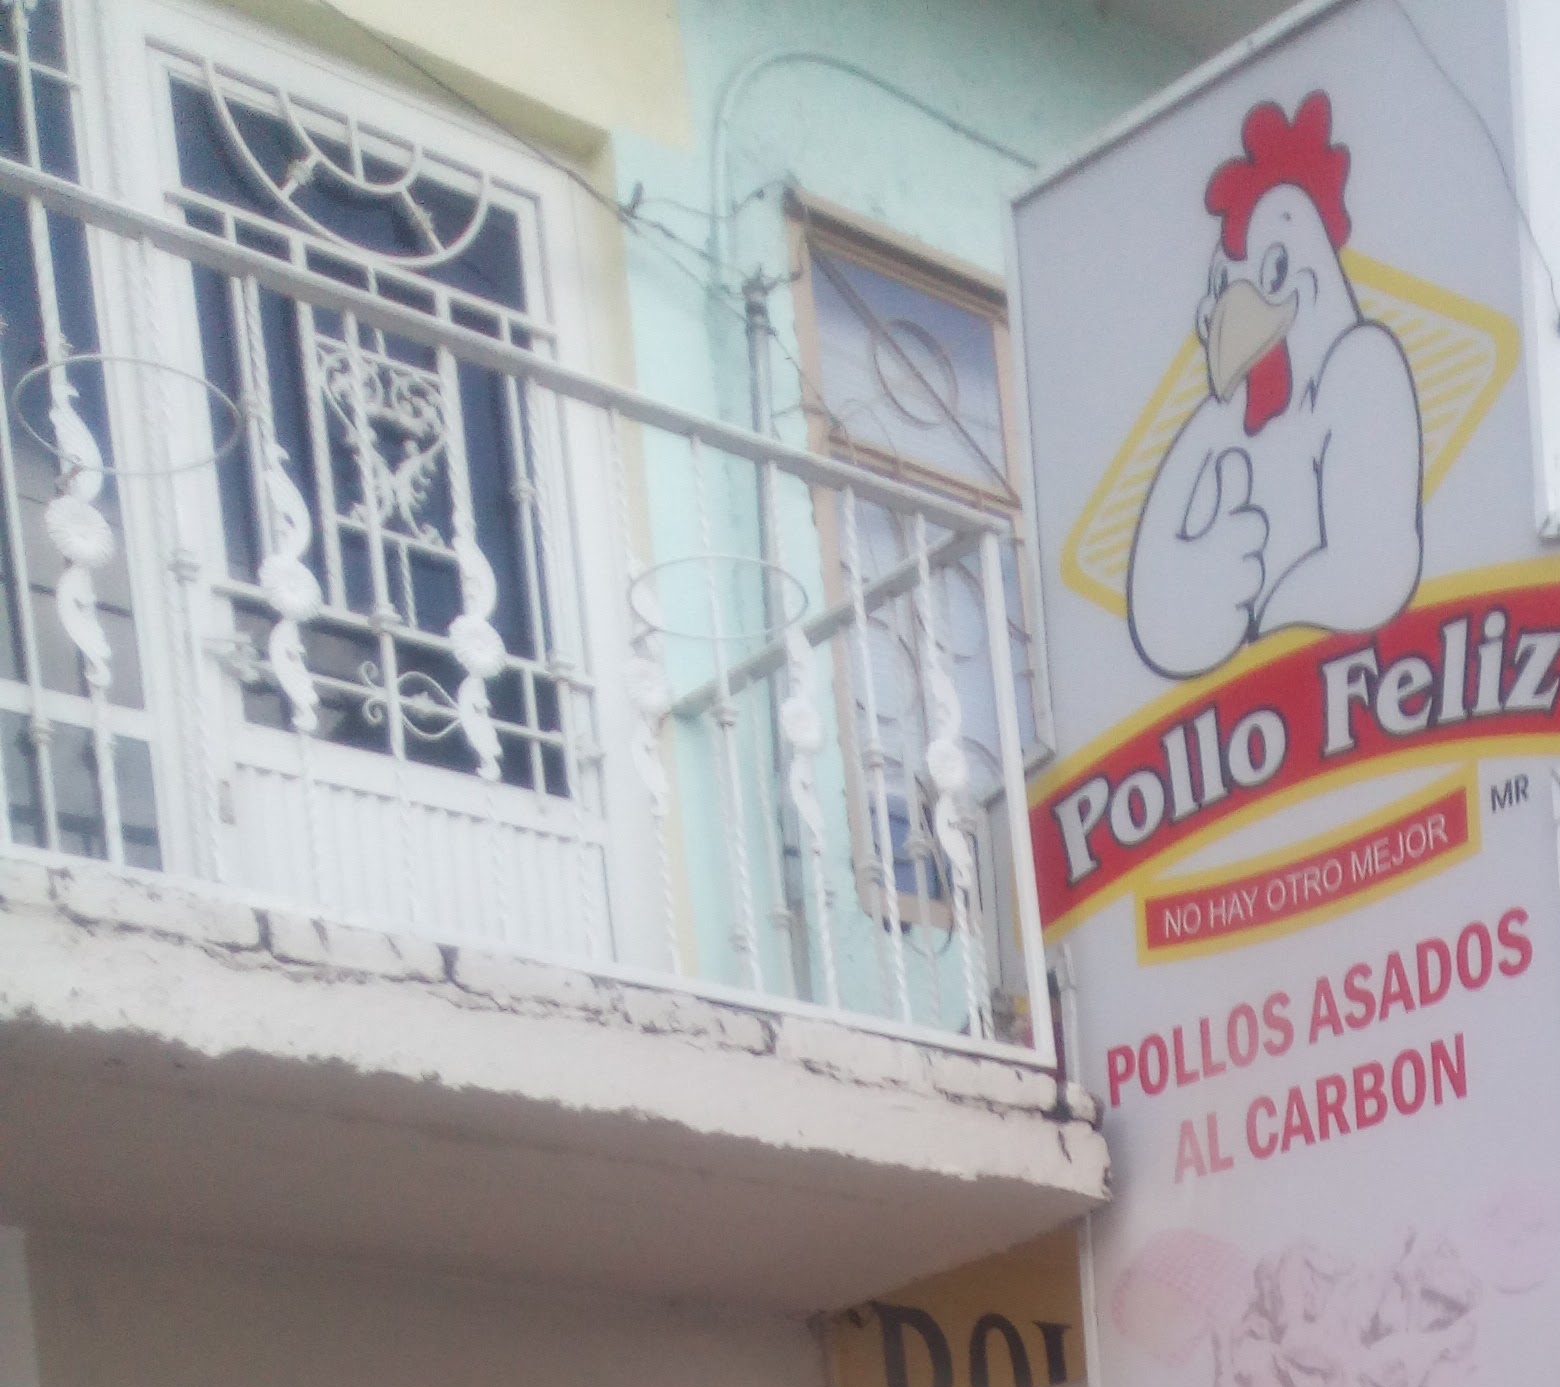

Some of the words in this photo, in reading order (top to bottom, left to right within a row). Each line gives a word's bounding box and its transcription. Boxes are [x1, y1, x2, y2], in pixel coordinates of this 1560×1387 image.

[1052, 706, 1289, 888] Pollo
[1489, 773, 1530, 814] MR
[1164, 904, 1202, 938] NO
[1209, 888, 1260, 928] HAY
[1266, 866, 1343, 910] OTRO
[1350, 815, 1449, 884] MEJOR
[1106, 992, 1295, 1109] POLLOS
[1307, 906, 1534, 1044] ASADOS
[1173, 1112, 1235, 1184] AL
[1245, 1032, 1469, 1160] CARBON
